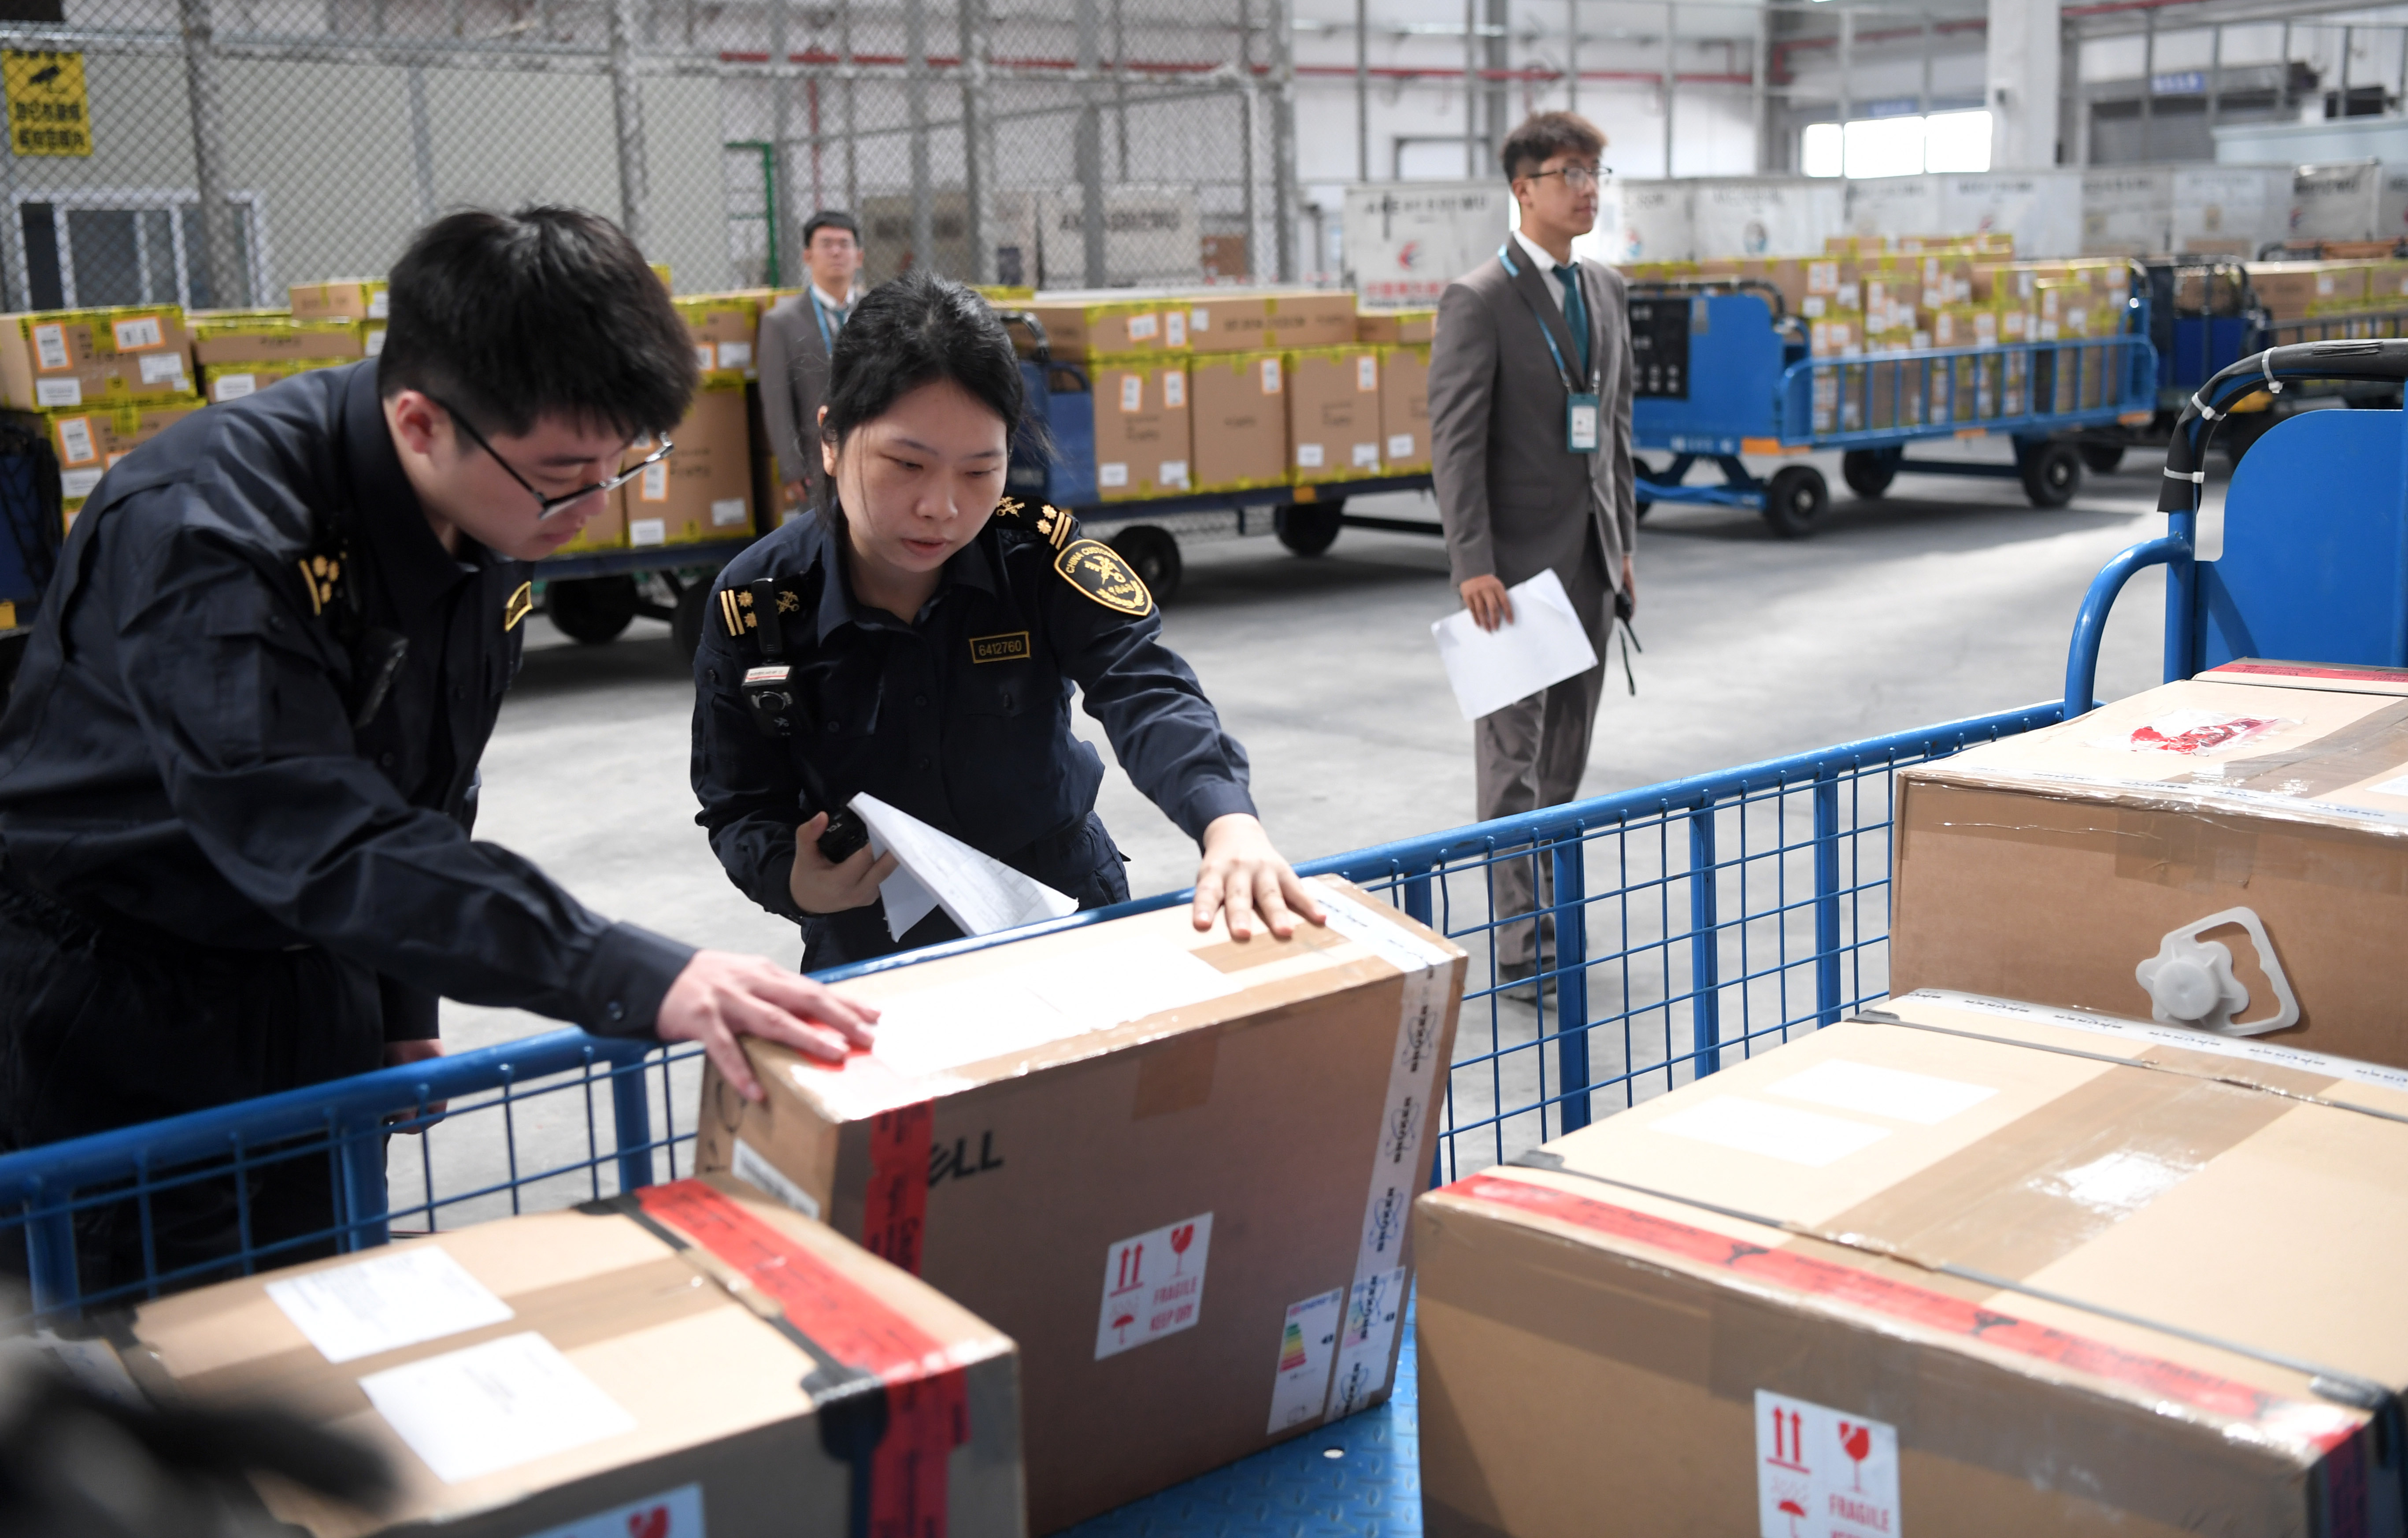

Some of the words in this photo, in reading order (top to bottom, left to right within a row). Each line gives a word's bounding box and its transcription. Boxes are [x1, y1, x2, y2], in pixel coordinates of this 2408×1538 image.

[1065, 552, 1085, 574] CHINA
[978, 640, 1022, 656] 6412760
[928, 1130, 1004, 1189] ELL
[1152, 1275, 1197, 1305] FRAGILE
[1149, 1309, 1174, 1331] KEEP
[1175, 1303, 1193, 1324] DRY
[1829, 1493, 1890, 1533] FRAGILE
